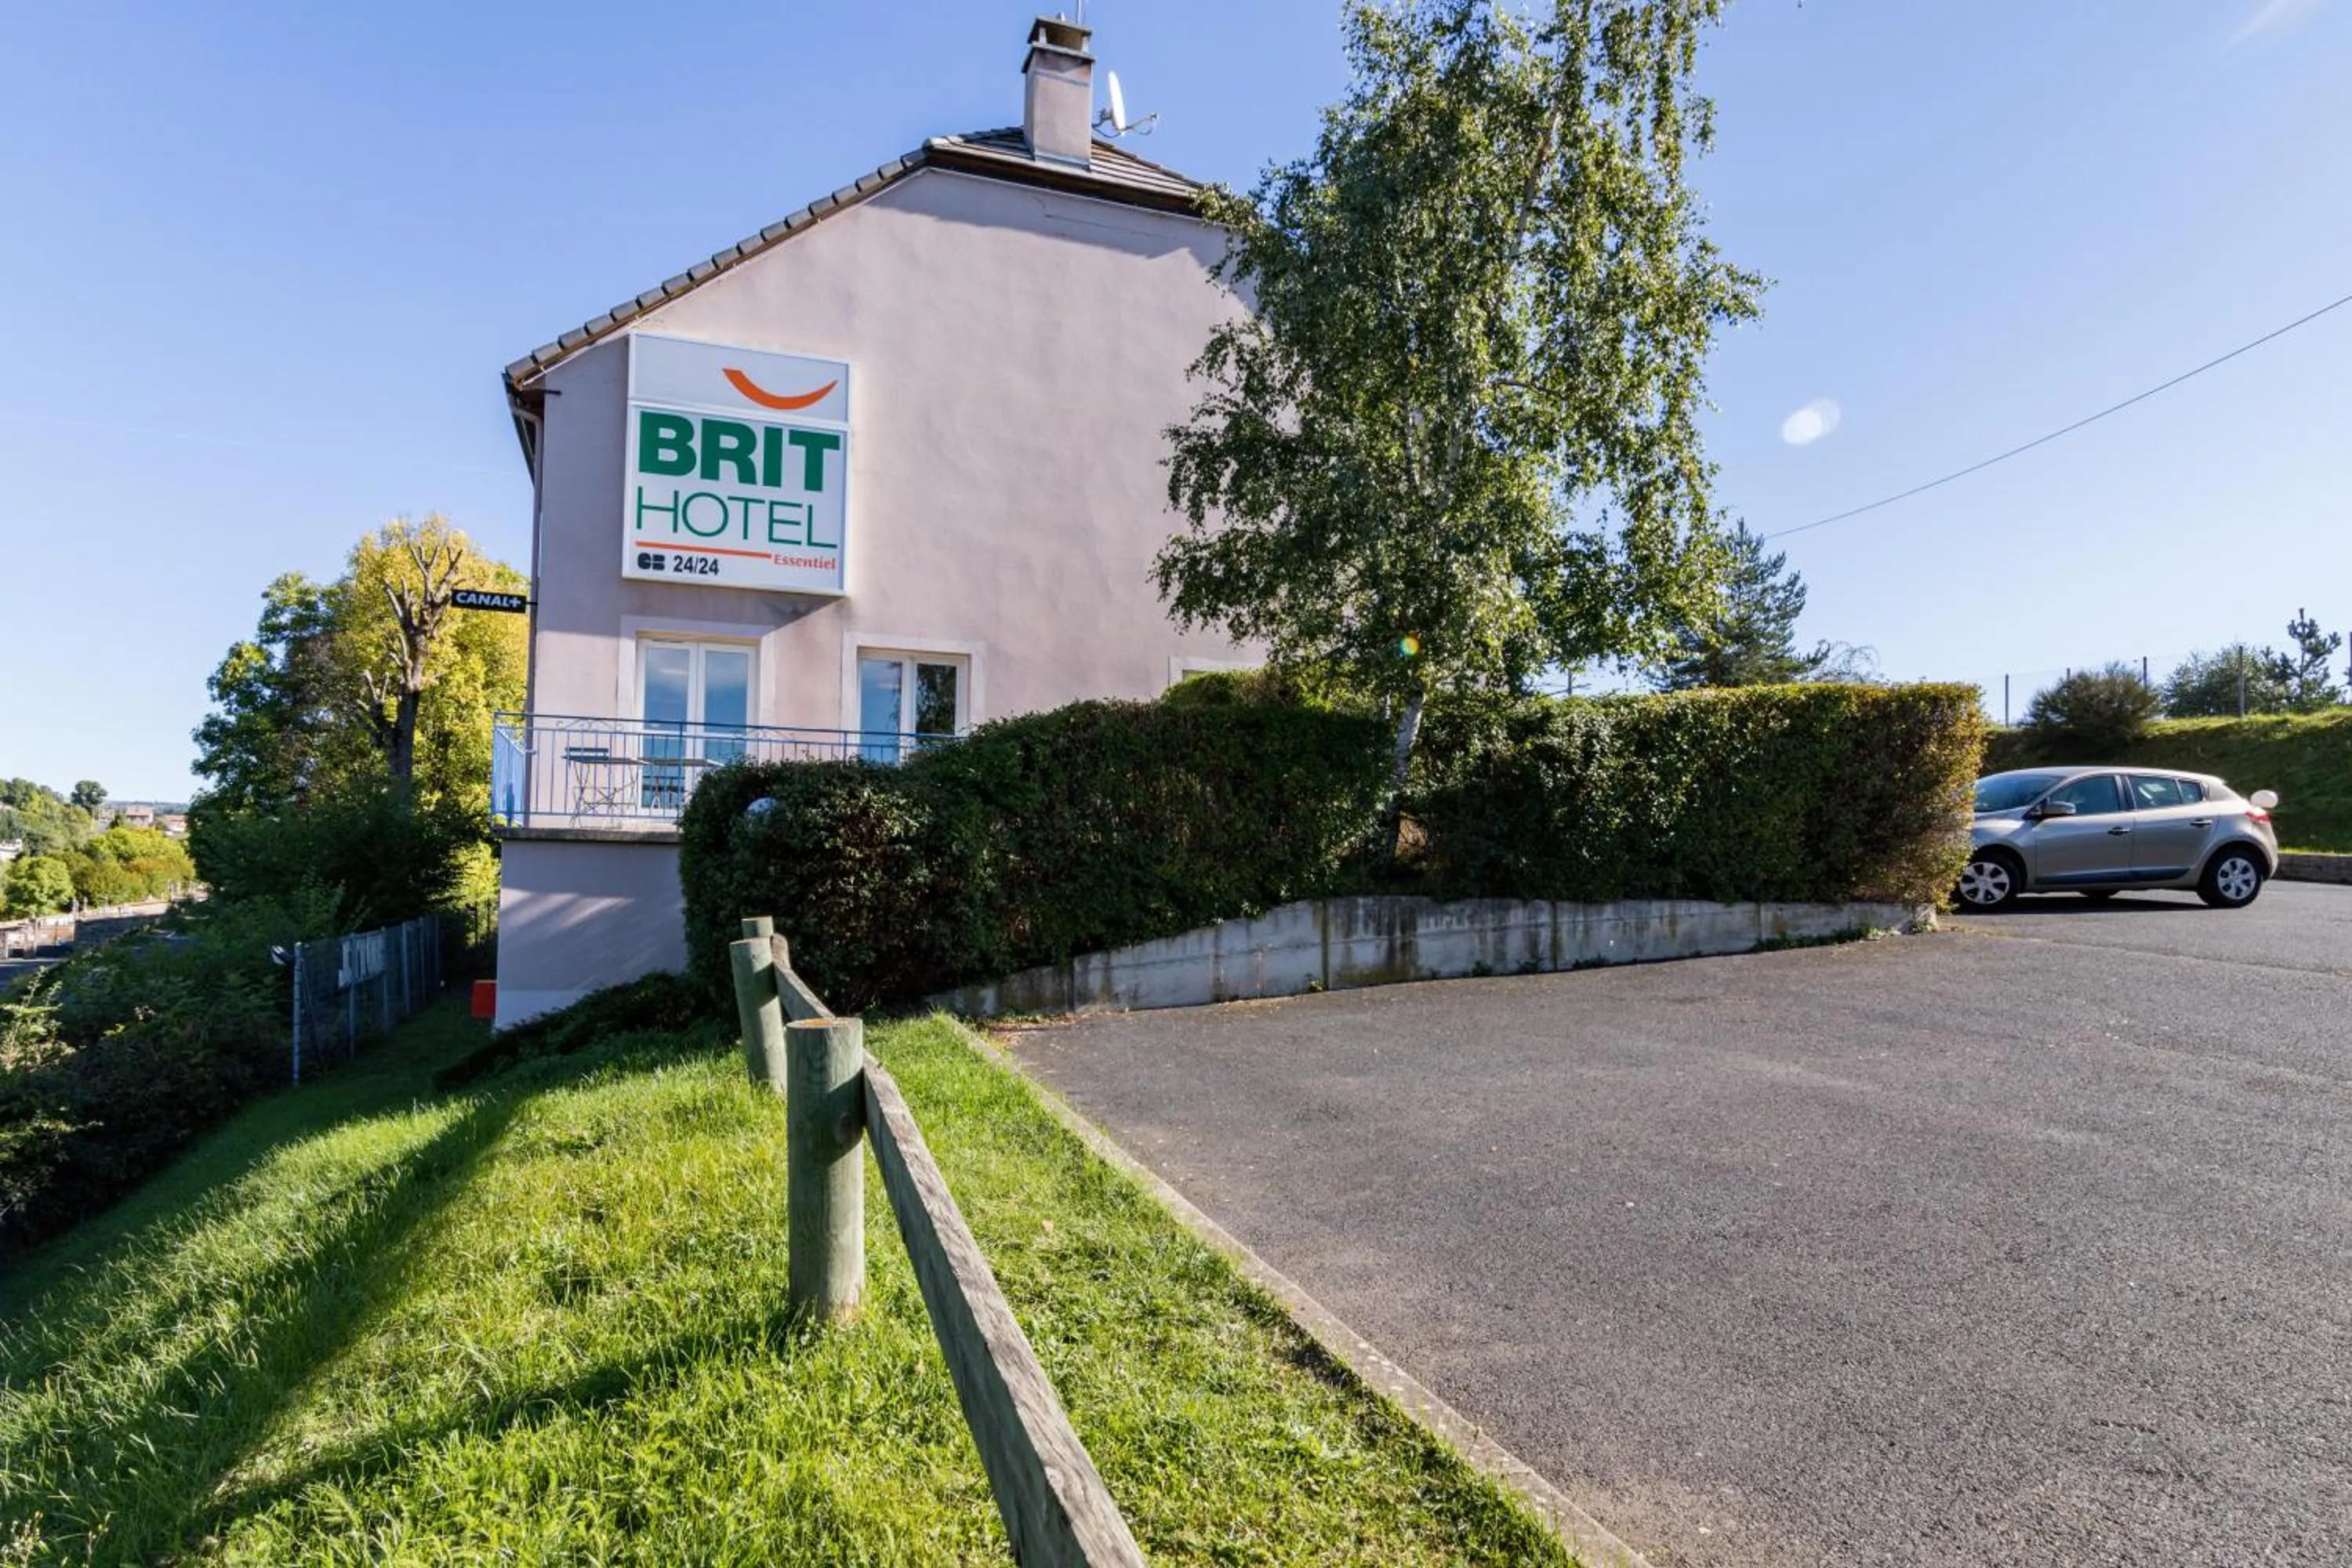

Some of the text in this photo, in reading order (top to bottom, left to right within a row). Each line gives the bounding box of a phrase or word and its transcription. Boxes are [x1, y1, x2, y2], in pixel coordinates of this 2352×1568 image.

[639, 411, 840, 492] BRIT
[636, 486, 838, 549] HOTEL
[673, 555, 720, 576] 24/24
[774, 554, 837, 571] Essentiel
[456, 592, 521, 608] CANAL+
